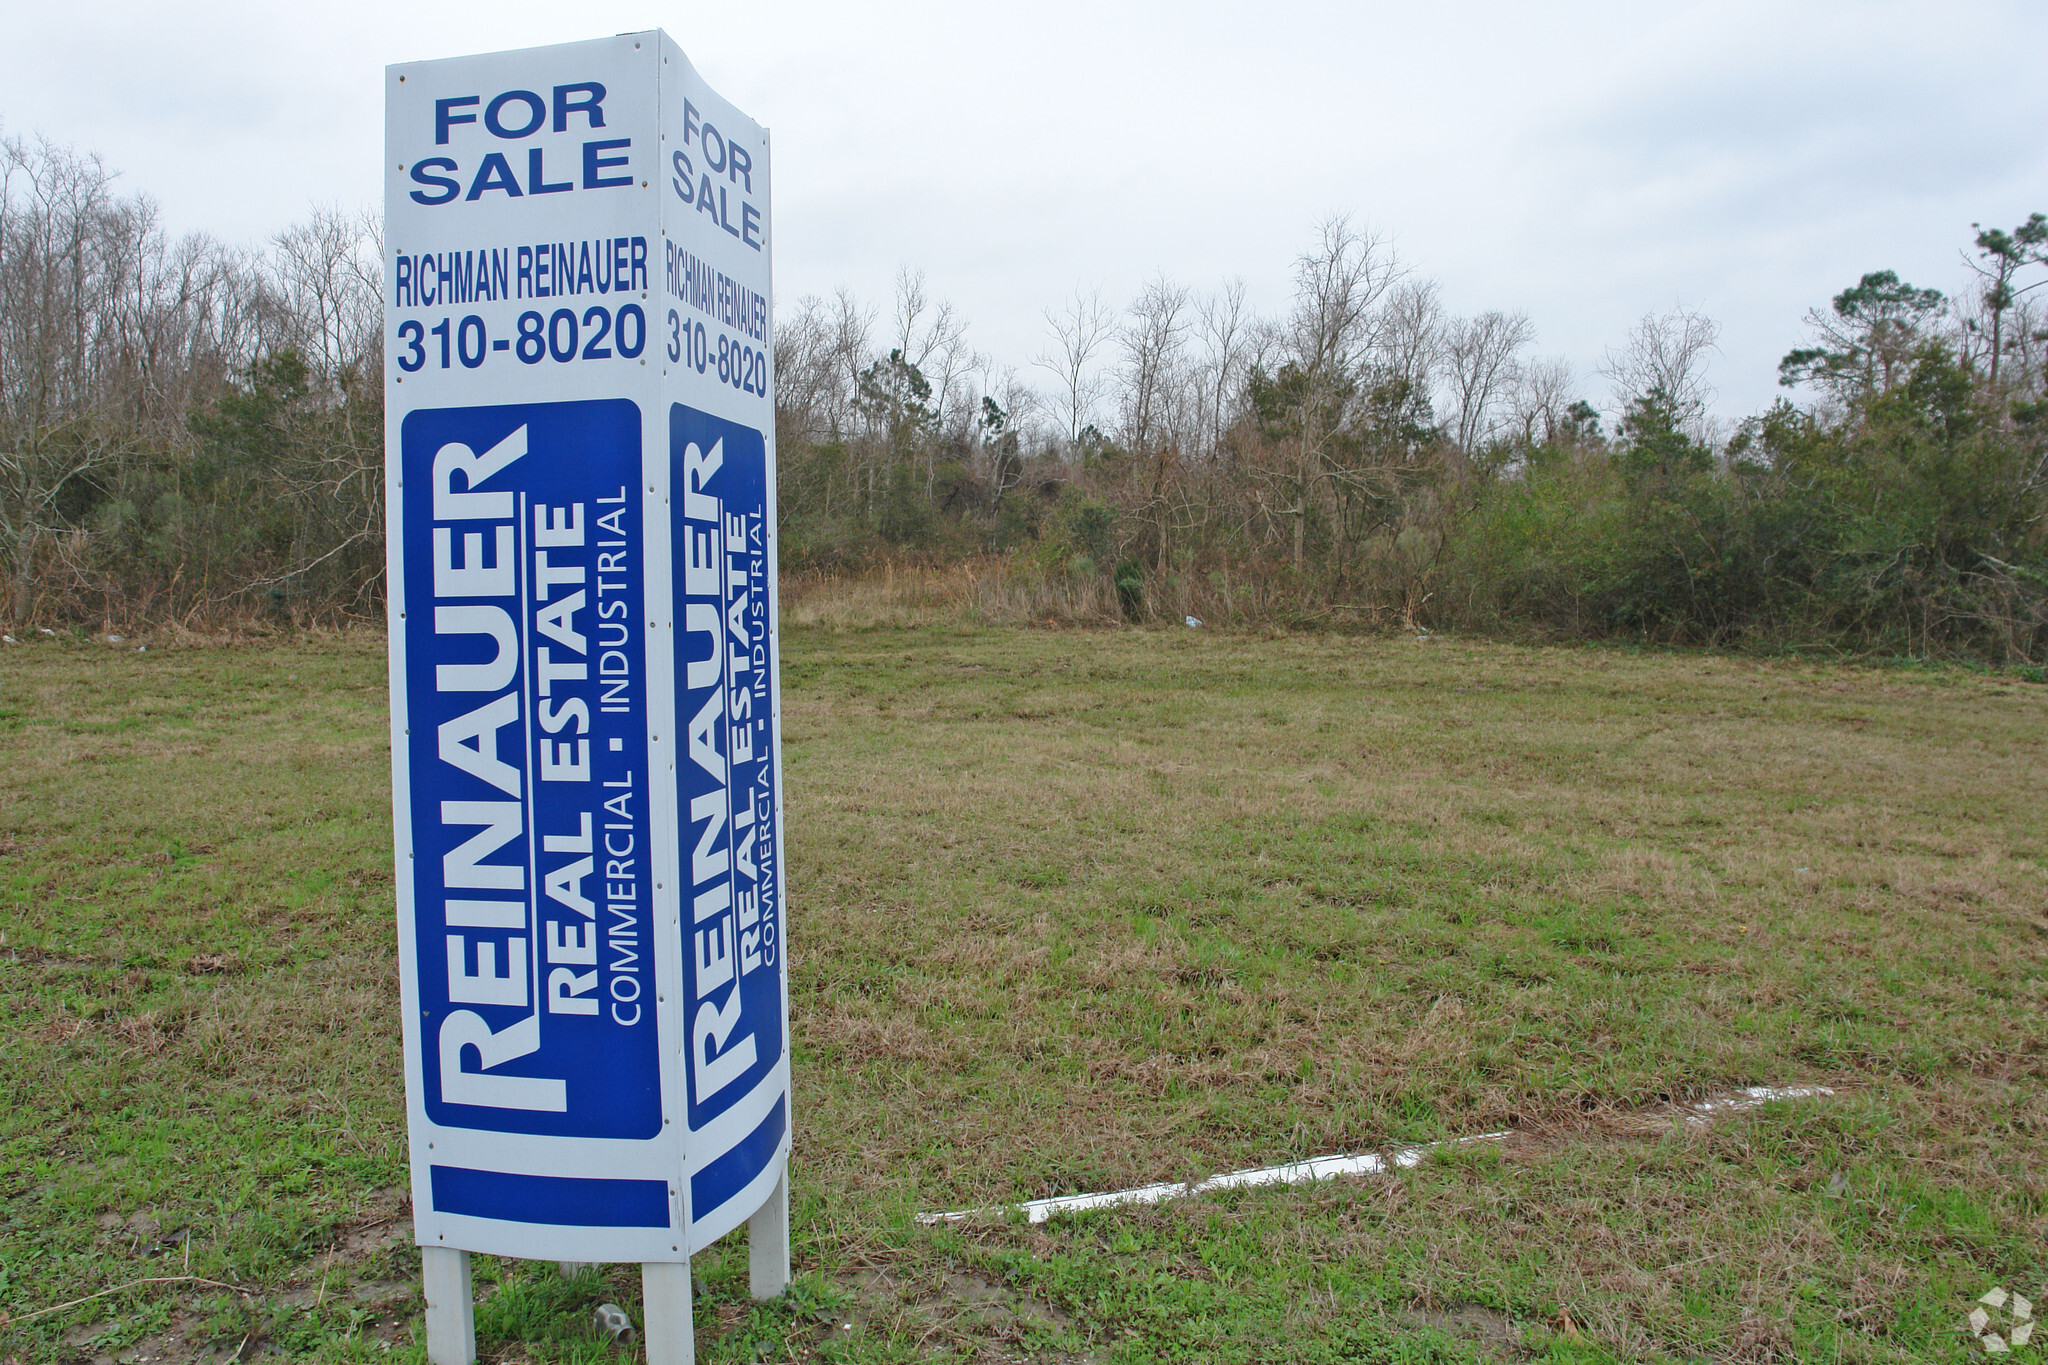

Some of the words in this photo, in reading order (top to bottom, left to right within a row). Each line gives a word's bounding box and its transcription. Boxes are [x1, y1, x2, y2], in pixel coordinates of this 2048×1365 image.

[409, 138, 634, 206] SALE
[435, 82, 607, 145] FOR
[672, 150, 761, 253] SALE
[683, 96, 753, 195] FOR
[396, 248, 508, 307] RICHMAN
[517, 236, 648, 299] REINAUER
[397, 303, 646, 372] 310-8020
[666, 238, 715, 317] RICHMAN
[717, 271, 767, 343] REINAUER
[667, 308, 766, 399] 310-8020
[534, 502, 591, 782] ESTATE
[597, 486, 630, 712] INDUSTRIAL
[726, 511, 753, 765] ESTATE
[749, 503, 768, 698] INDUSTRIAL
[433, 423, 567, 1112] REINAUER
[683, 436, 757, 1105] REINAUER
[756, 745, 775, 967] COMMERCIAL
[543, 812, 599, 1015] REAL
[603, 770, 641, 1026] COMMERCIAL
[735, 787, 762, 976] REAL
